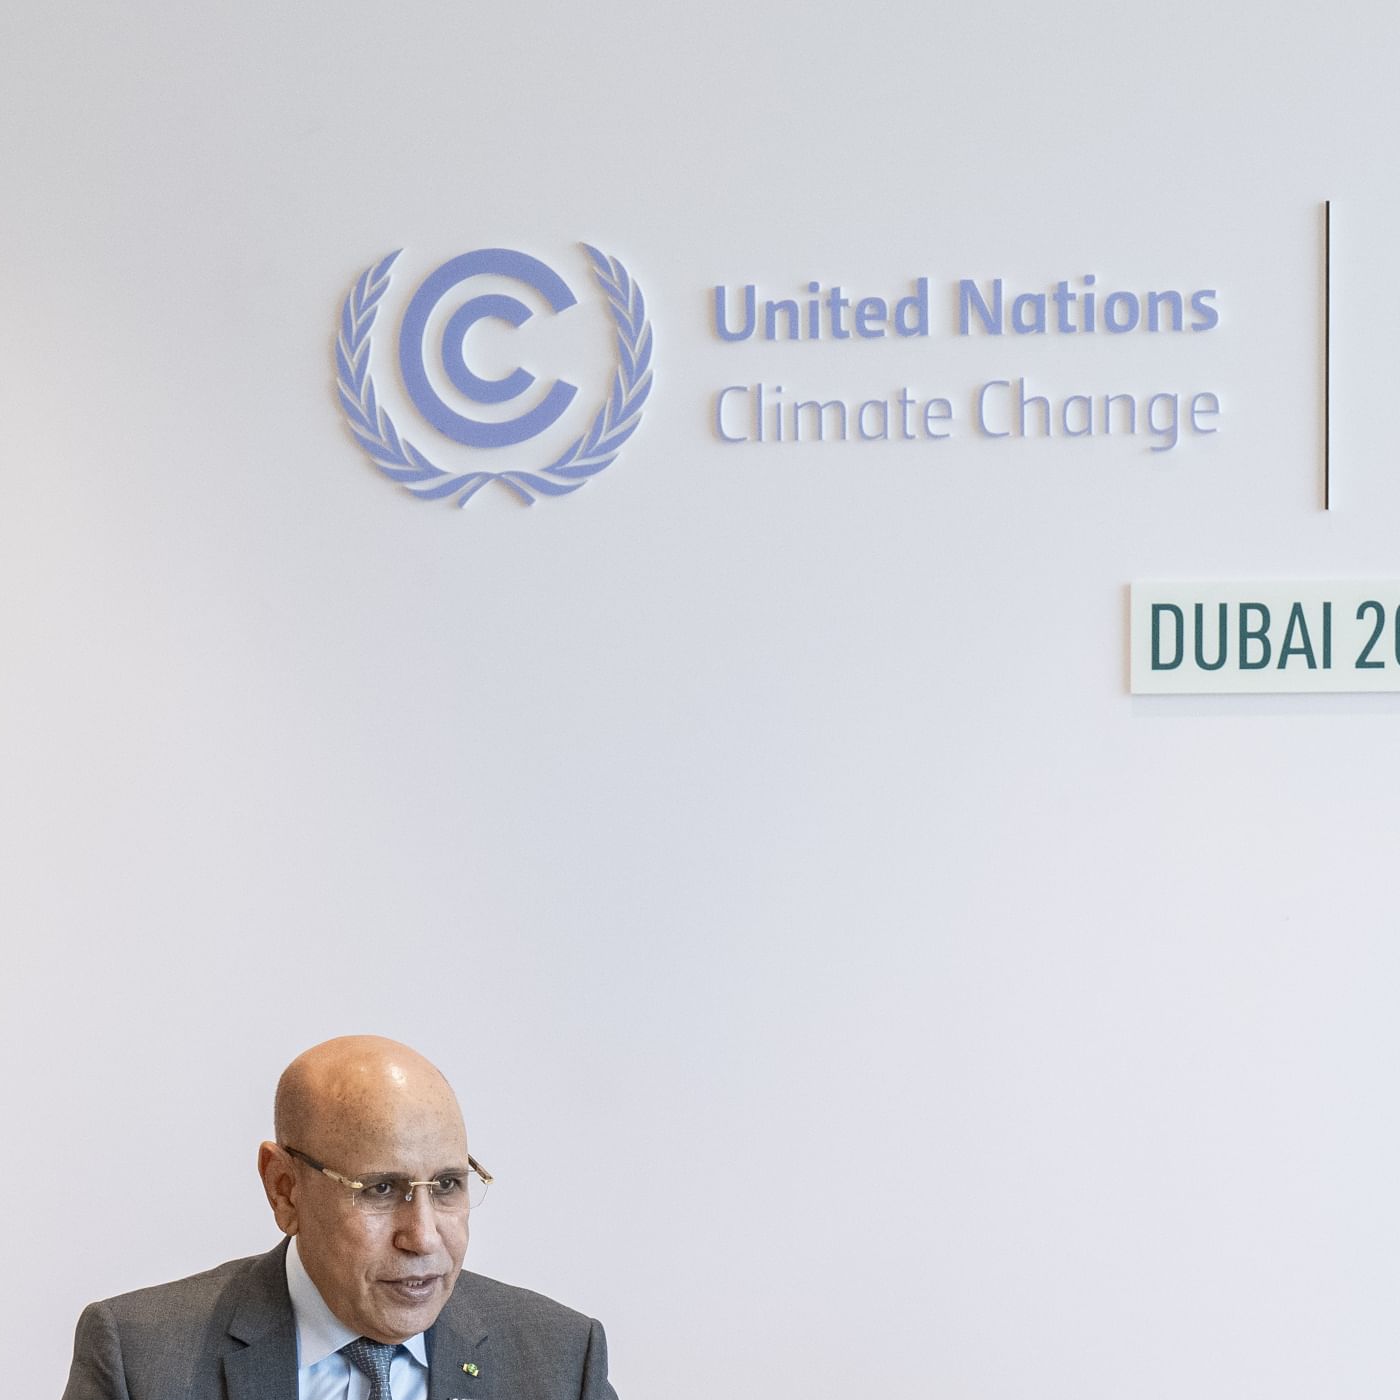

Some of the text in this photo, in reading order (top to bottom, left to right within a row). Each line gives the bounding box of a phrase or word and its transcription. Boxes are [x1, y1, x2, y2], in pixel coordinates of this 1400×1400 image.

[713, 274, 1220, 342] United Nations
[713, 377, 1221, 453] Climate Change
[1151, 602, 1333, 671] DUBAI
